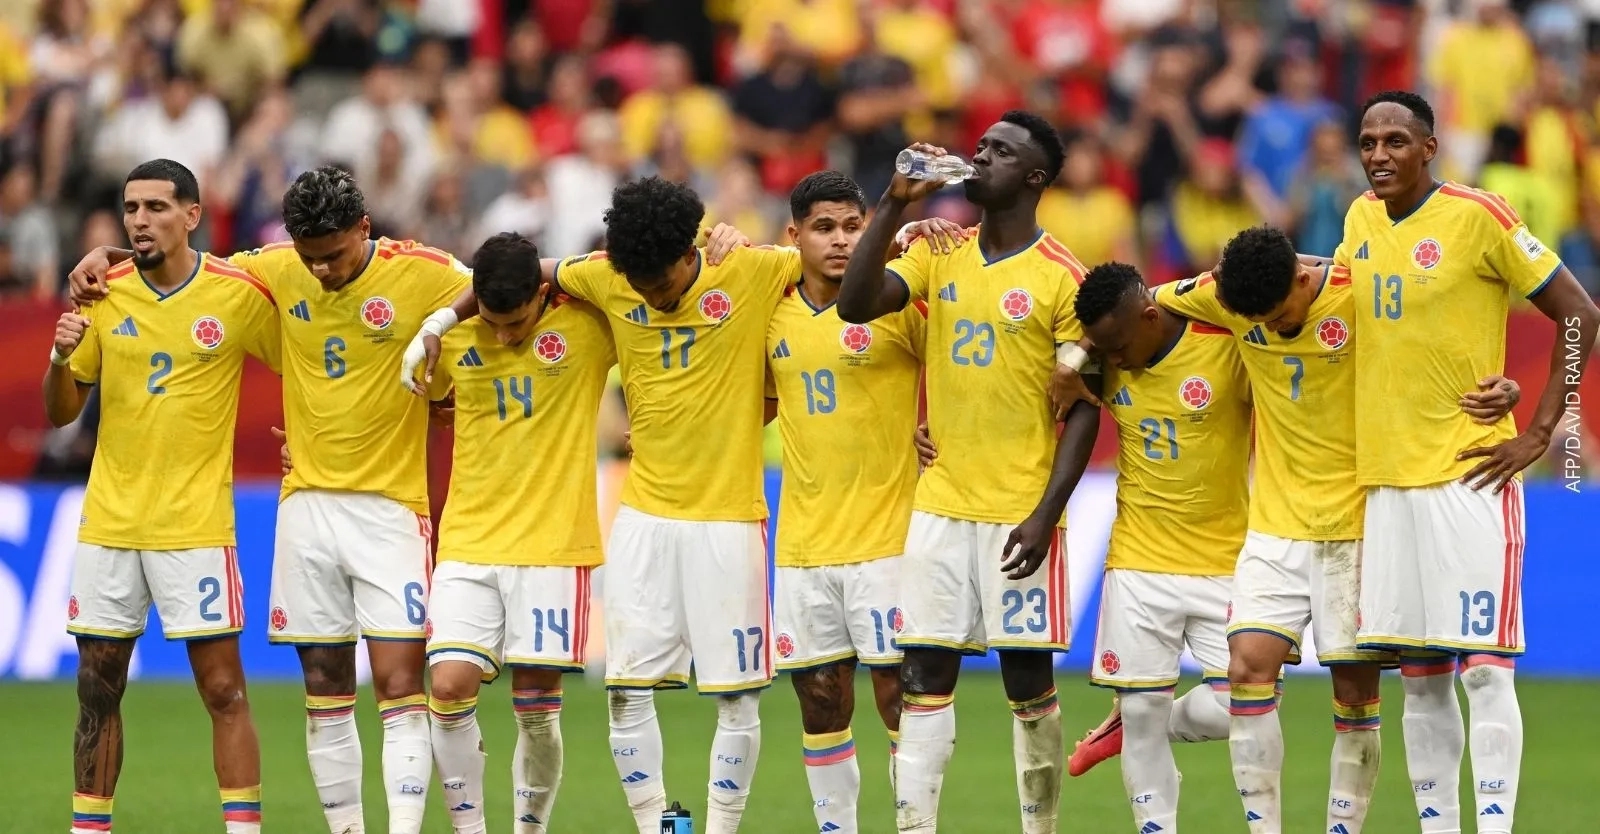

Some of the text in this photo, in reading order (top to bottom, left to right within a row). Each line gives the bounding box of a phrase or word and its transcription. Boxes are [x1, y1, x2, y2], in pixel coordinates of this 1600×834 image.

[1373, 272, 1403, 320] 13
[325, 336, 346, 378] 6
[661, 327, 696, 368] 17
[952, 319, 995, 367] 23
[147, 352, 172, 394] 2
[801, 368, 837, 415] 19
[1283, 356, 1304, 400] 7
[493, 375, 532, 420] 14
[1140, 417, 1178, 460] 21
[199, 576, 222, 621] 2
[404, 581, 426, 625] 6
[1002, 588, 1047, 633] 23
[1459, 590, 1495, 637] 13
[532, 608, 569, 652] 14
[732, 626, 763, 672] 17
[613, 747, 639, 757] FCF
[717, 754, 743, 765] FCF
[1331, 798, 1351, 809] FCF
[1414, 781, 1437, 793] FCF
[1480, 779, 1505, 790] FCF
